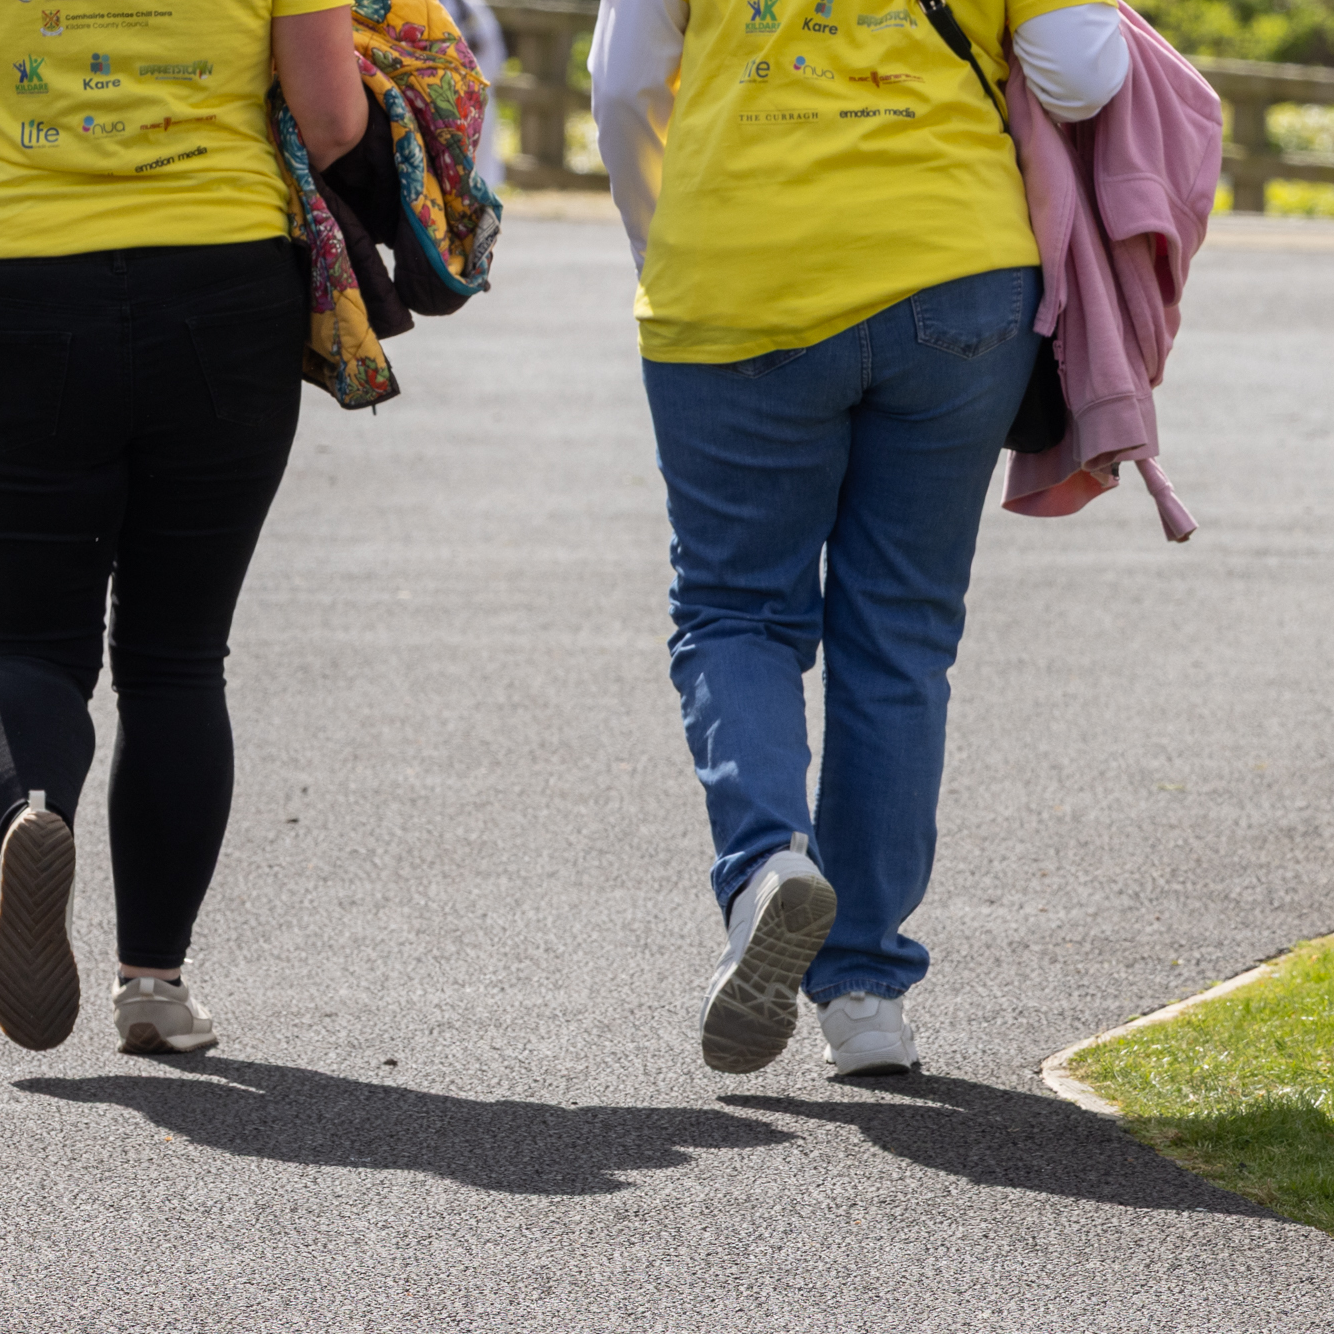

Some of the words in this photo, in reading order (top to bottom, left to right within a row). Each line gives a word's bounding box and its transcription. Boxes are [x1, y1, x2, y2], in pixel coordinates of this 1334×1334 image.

[65, 12, 105, 21] Comhairle
[106, 11, 134, 19] Contae
[135, 10, 153, 18] Chill
[65, 21, 91, 30] Kildare
[92, 21, 119, 31] County
[120, 19, 149, 28] Council
[802, 17, 838, 35] Kare
[803, 65, 835, 80] nua
[15, 83, 49, 91] KILDARE
[83, 77, 121, 91] Kare
[739, 113, 760, 122] THE
[765, 112, 819, 122] CURRAGH
[839, 107, 880, 119] emotion
[884, 107, 916, 119] media
[92, 121, 126, 135] nua
[134, 155, 175, 174] emotion
[177, 145, 208, 163] media
